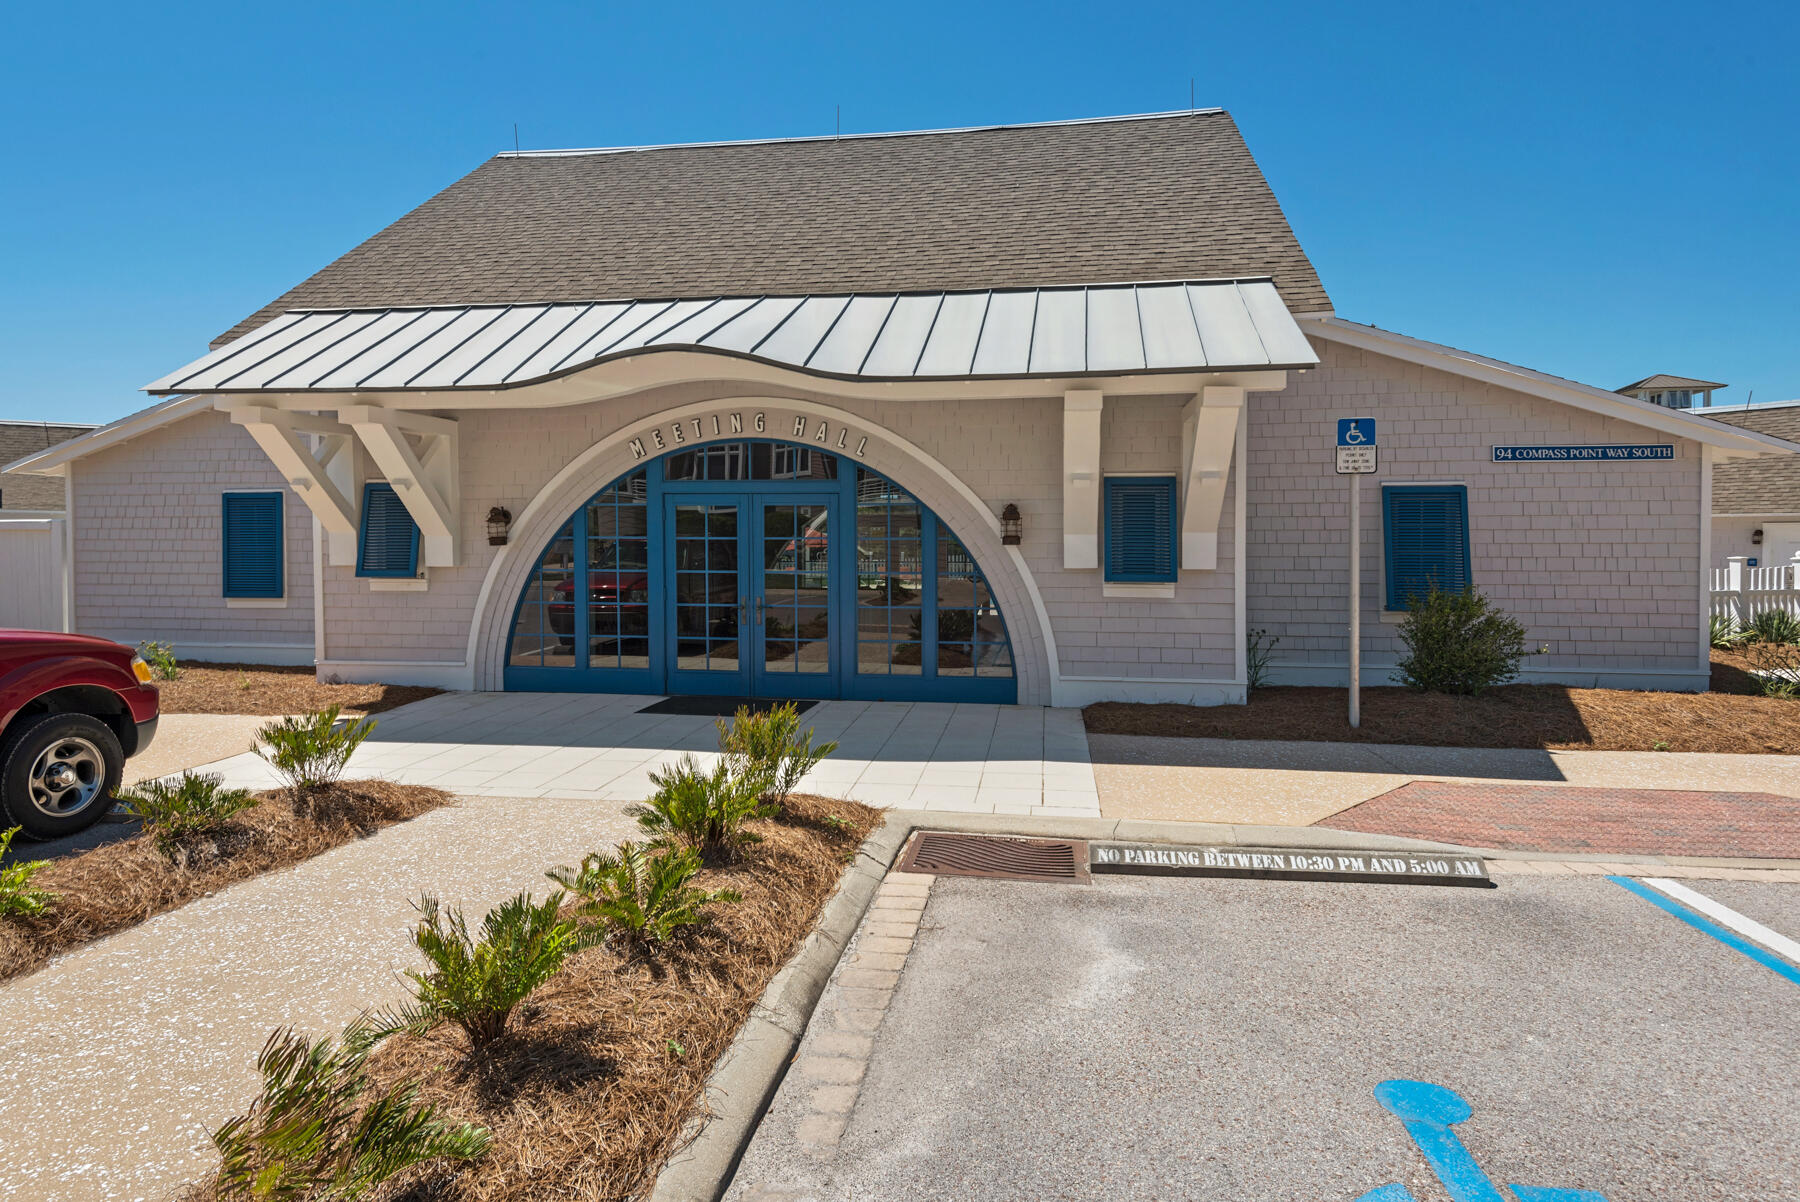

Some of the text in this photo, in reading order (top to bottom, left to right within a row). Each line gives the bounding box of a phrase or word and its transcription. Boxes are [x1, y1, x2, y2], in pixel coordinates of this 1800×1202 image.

[628, 412, 868, 459] MEETING HALL
[1496, 447, 1672, 460] 94 COMPASS POINT WAY SOUTH
[1097, 848, 1482, 876] NO PARKING BETWEEN 10:30 PM AND 5:00 AM
